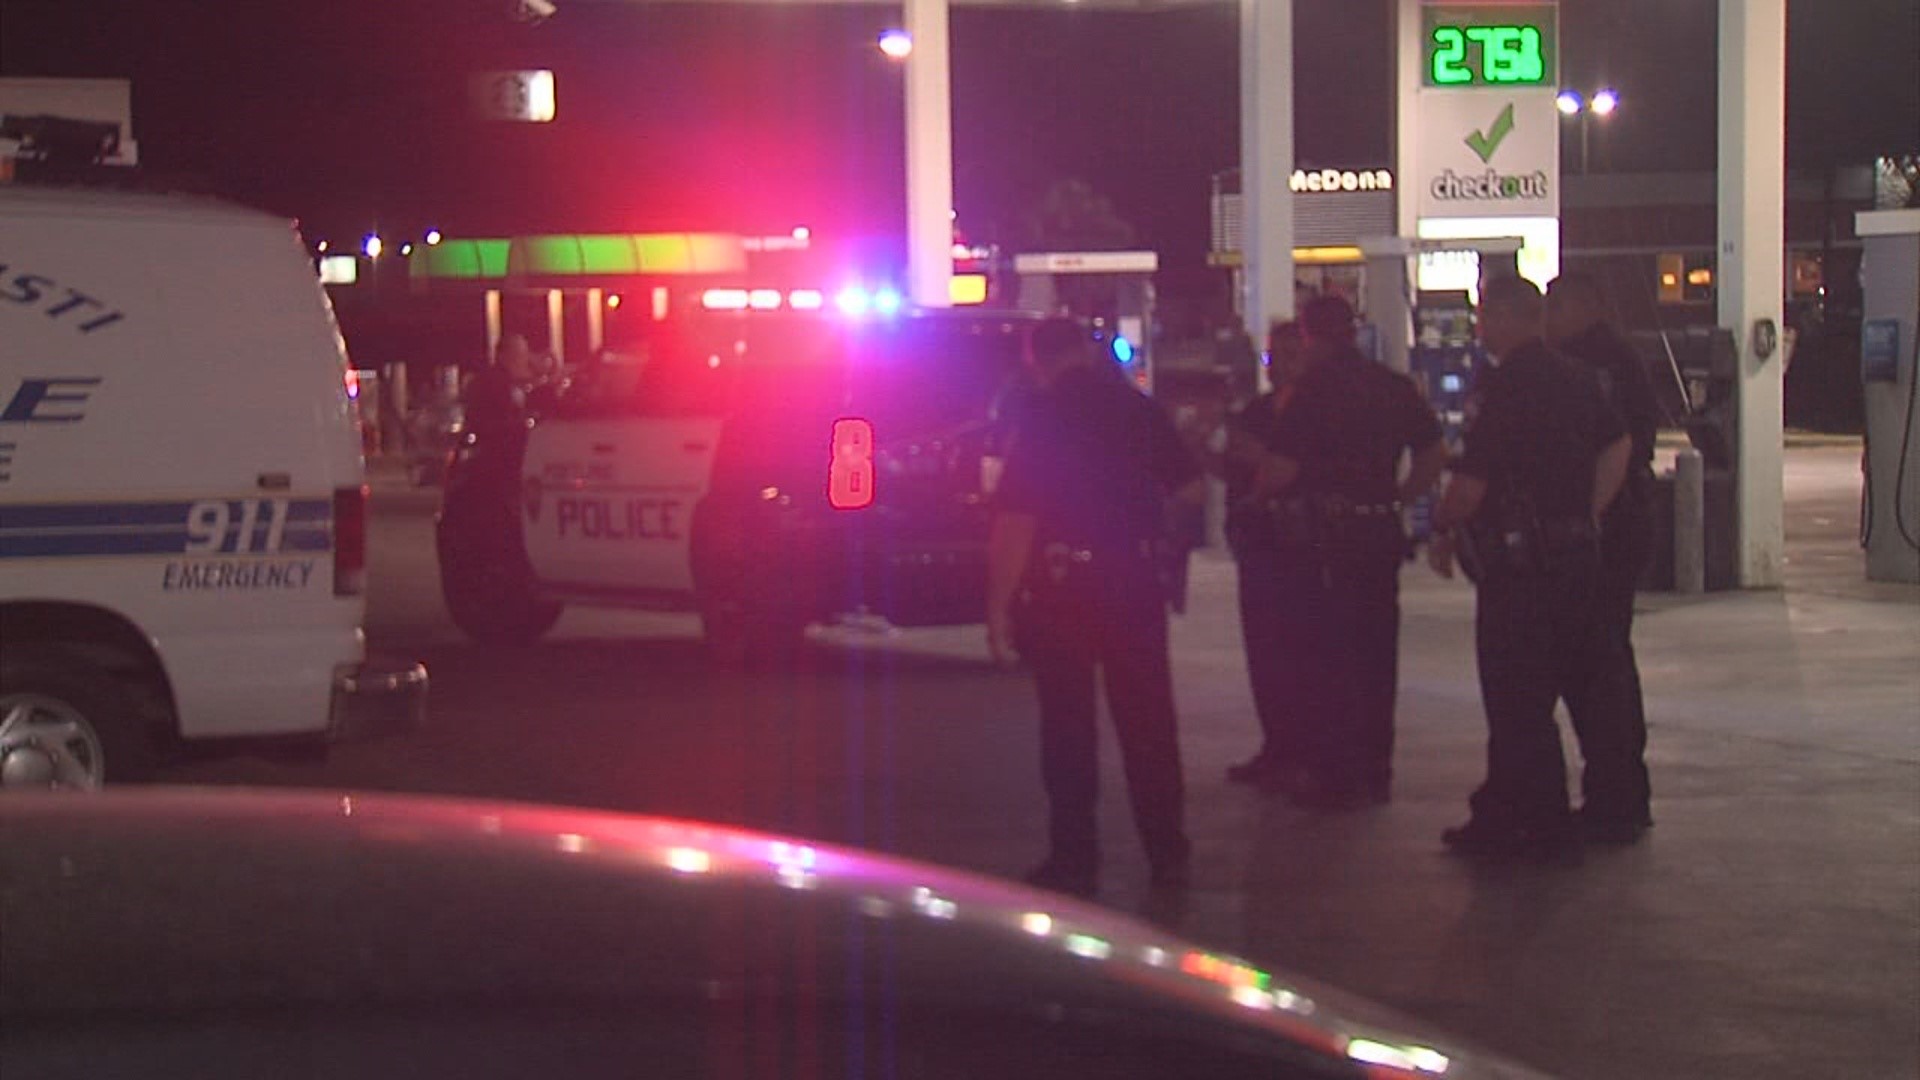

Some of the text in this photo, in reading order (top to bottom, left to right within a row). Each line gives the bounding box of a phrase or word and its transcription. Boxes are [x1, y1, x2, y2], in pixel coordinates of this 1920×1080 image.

[1431, 168, 1546, 200] checkout
[0, 264, 125, 334] STI
[184, 499, 288, 554] 911
[558, 498, 681, 539] POLICE
[163, 559, 313, 589] EMERGENCY
